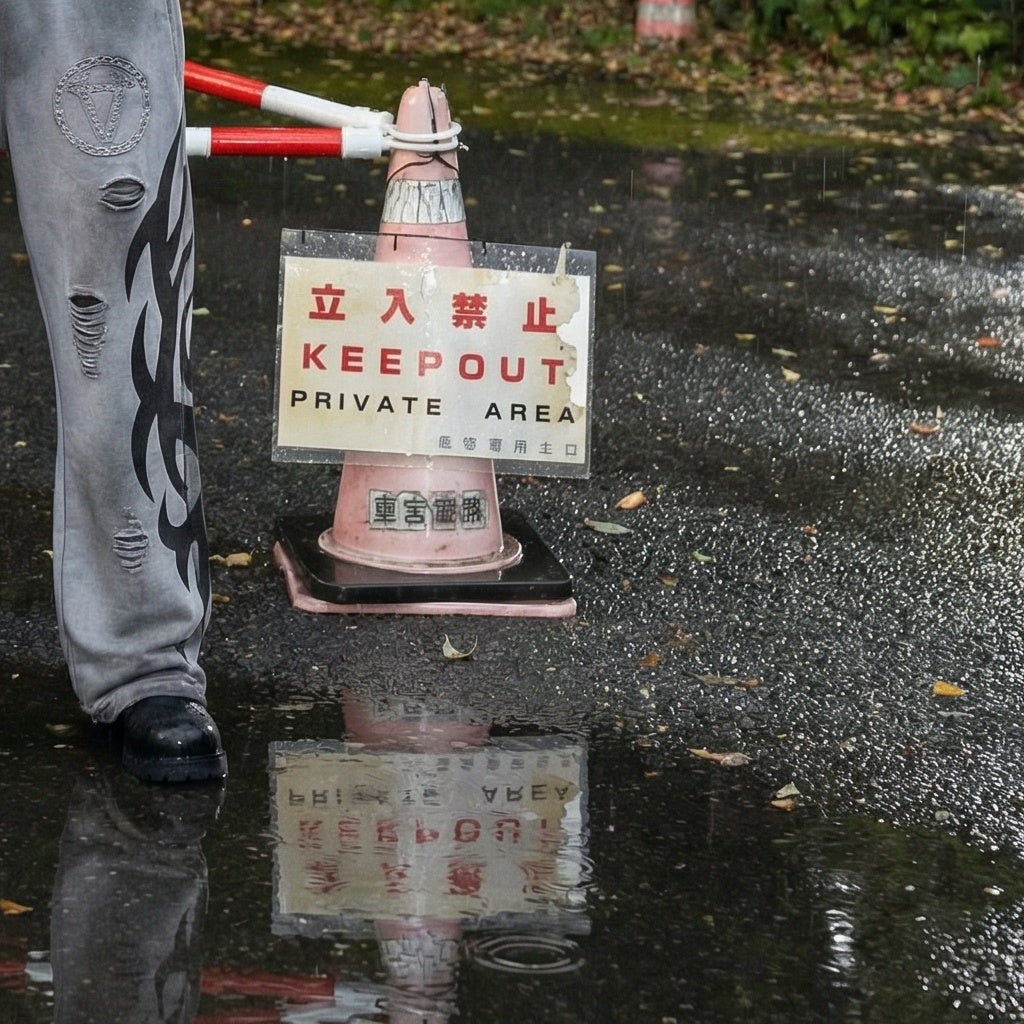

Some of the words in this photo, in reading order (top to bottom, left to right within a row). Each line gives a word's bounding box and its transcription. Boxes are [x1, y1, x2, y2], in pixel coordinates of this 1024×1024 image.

[309, 284, 557, 334] 立入禁止
[290, 390, 442, 416] PRIVATE
[484, 403, 575, 424] AREA
